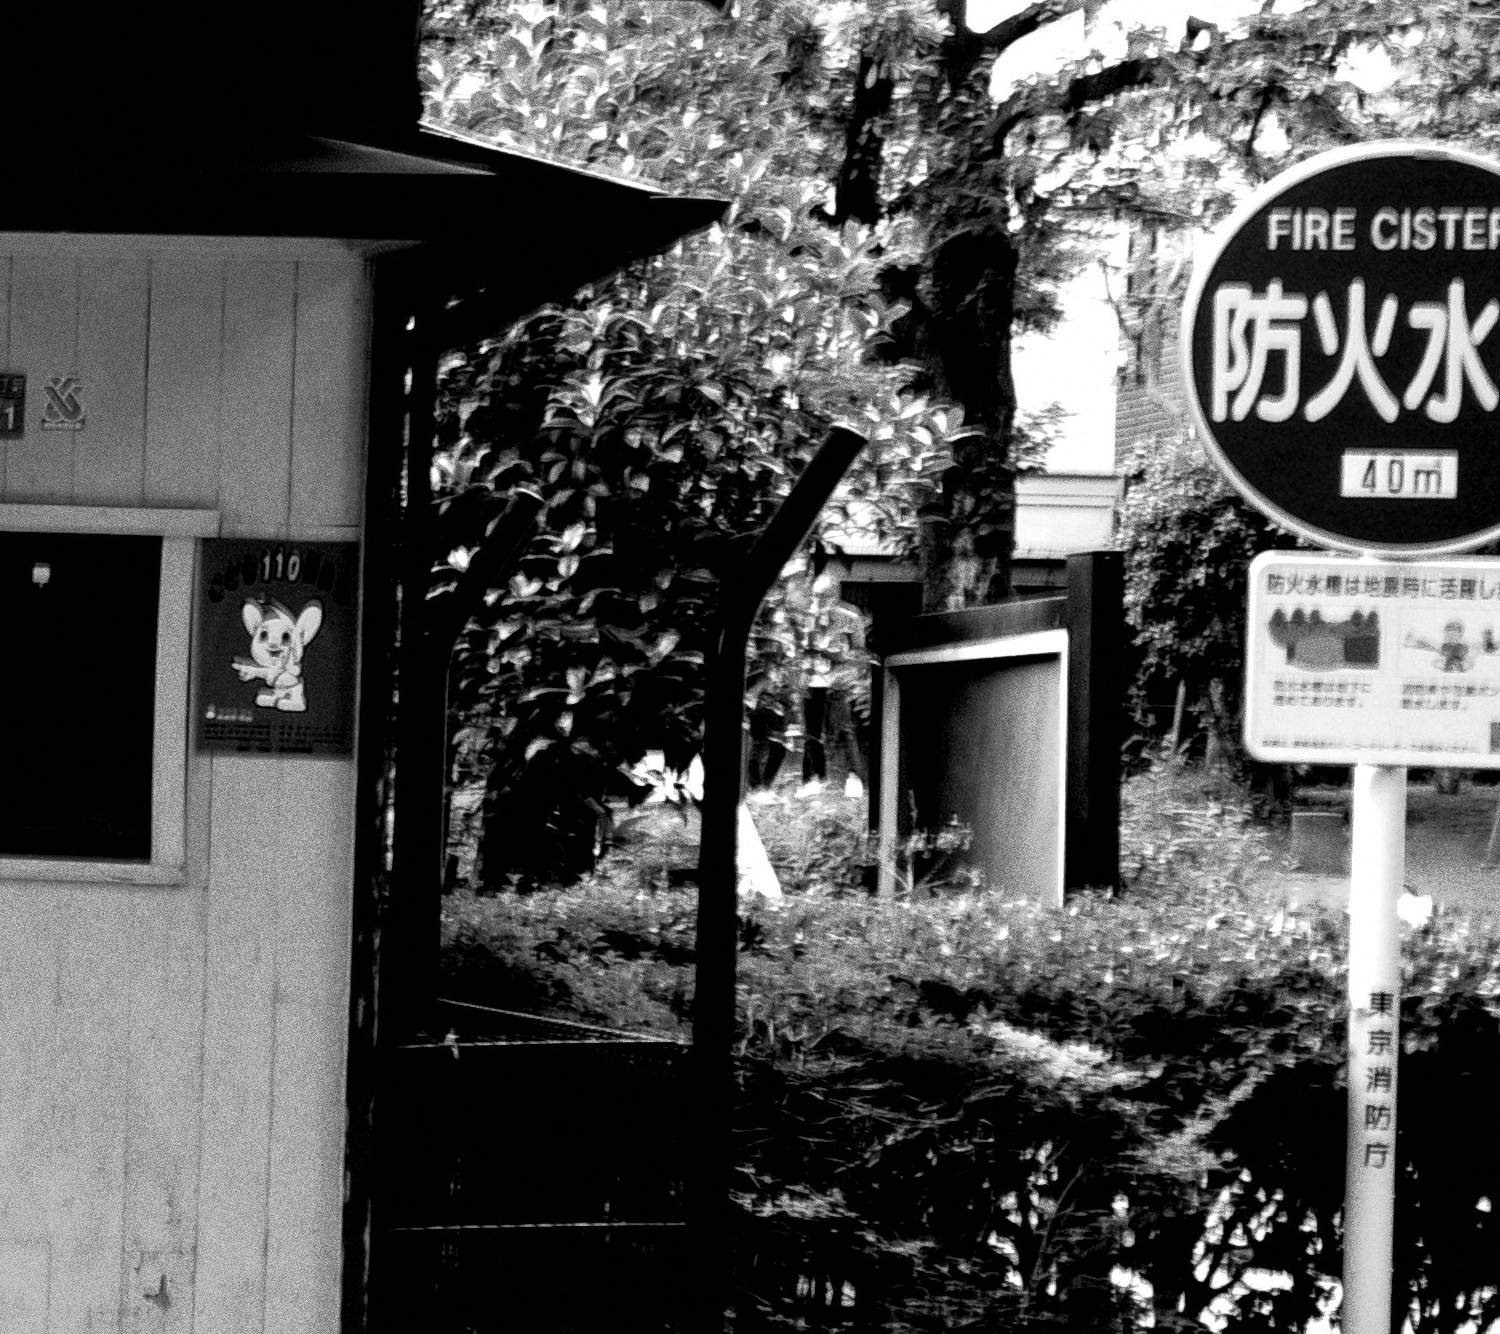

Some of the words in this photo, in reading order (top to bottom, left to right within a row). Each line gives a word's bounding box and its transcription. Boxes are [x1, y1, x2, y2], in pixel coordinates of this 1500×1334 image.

[1267, 207, 1357, 250] FIRE
[1211, 277, 1499, 424] 防火水
[1266, 573, 1500, 600] 防火水槽は地震時に活躍し
[1363, 991, 1395, 1169] 東京消防庁
